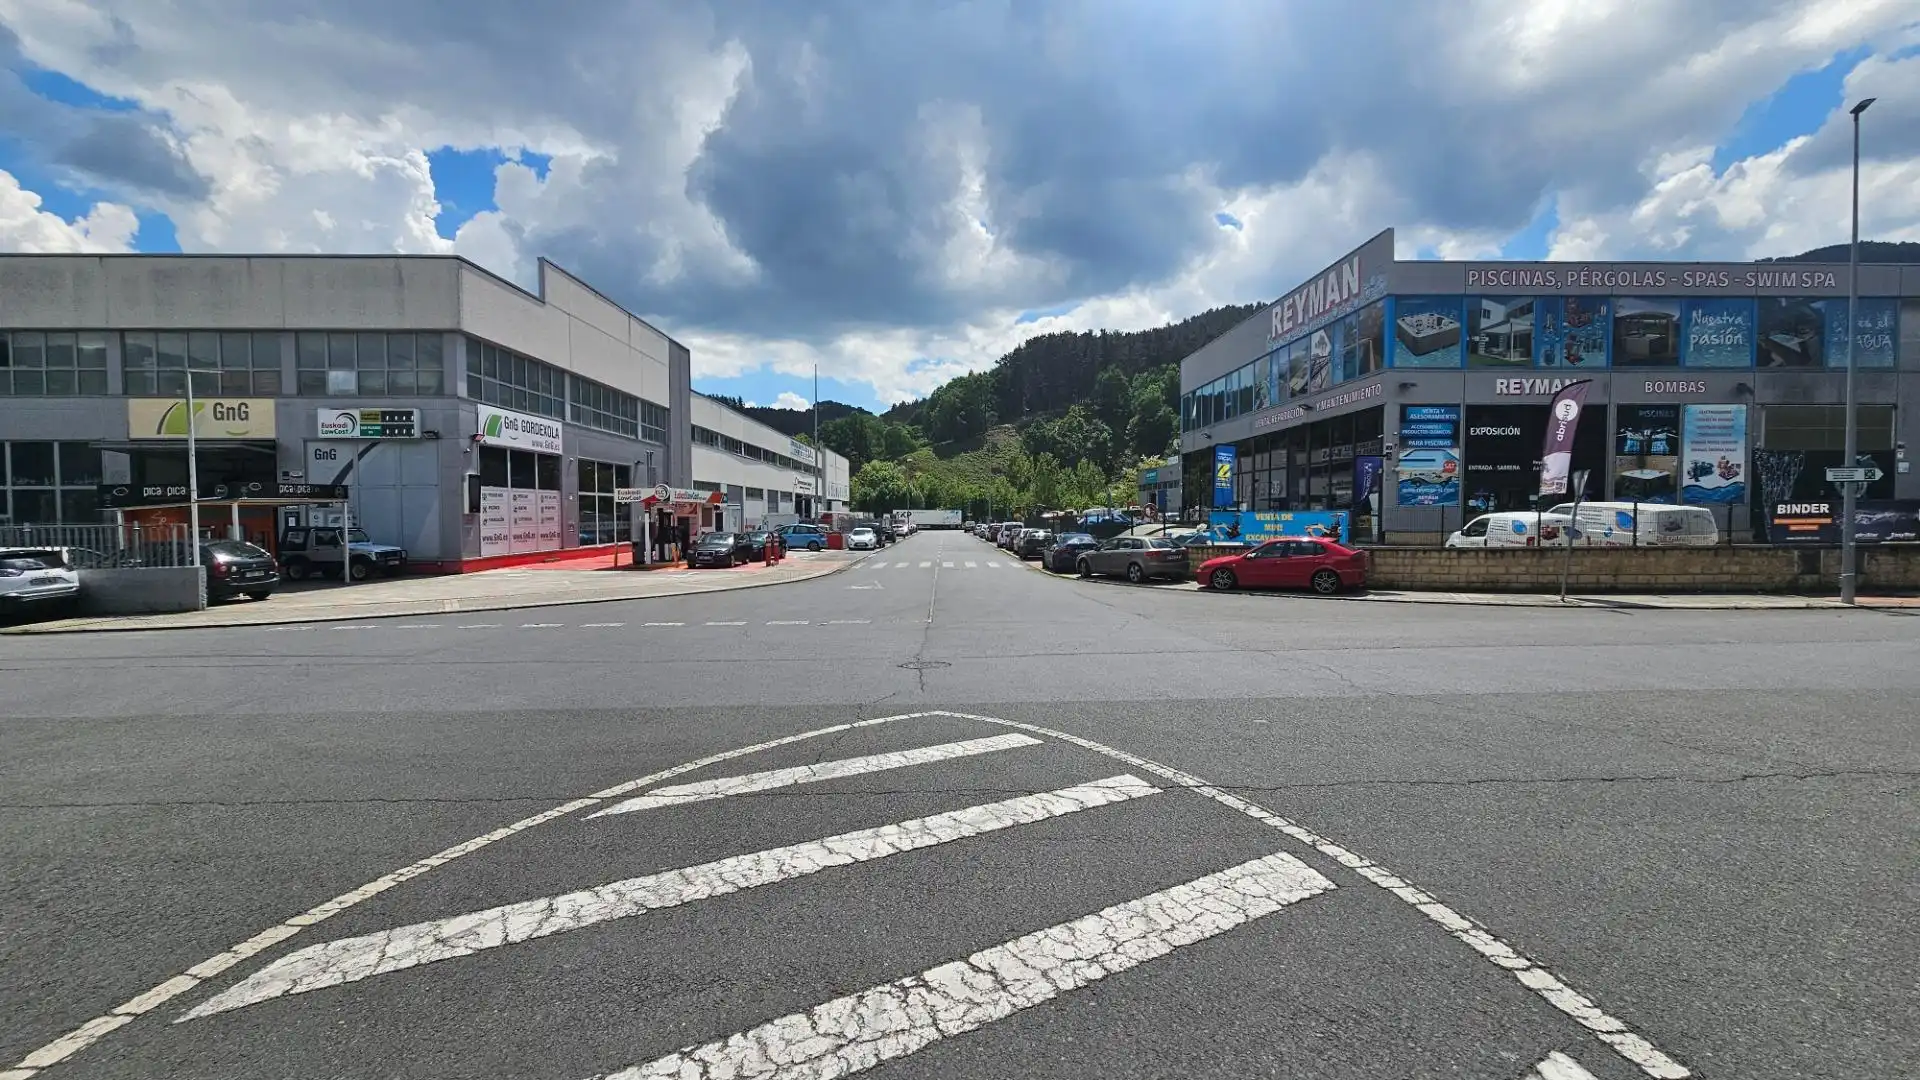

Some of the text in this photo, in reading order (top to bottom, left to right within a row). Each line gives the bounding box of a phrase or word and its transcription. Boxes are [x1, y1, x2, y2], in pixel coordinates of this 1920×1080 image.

[1468, 270, 1563, 289] PISCINAS,
[1567, 267, 1666, 287] PÉRGOLAS
[1683, 271, 1729, 288] SPAS
[1744, 272, 1797, 288] SWIM
[1801, 272, 1836, 288] SPA
[1271, 255, 1361, 340] REYMAN
[1692, 310, 1743, 326] Nuestra
[1690, 328, 1743, 351] pasión
[1645, 381, 1706, 393] BOMBAS
[1321, 383, 1382, 411] MANTENIMIENTO
[212, 402, 250, 421] GnG
[504, 416, 560, 440] GnG GORDEXOLA
[1470, 425, 1521, 436] EXPOSICIÓN
[1555, 403, 1572, 442] abrisud
[315, 448, 337, 460] GnG
[1255, 513, 1294, 521] VENTA DE
[1776, 504, 1830, 515] BINDER
